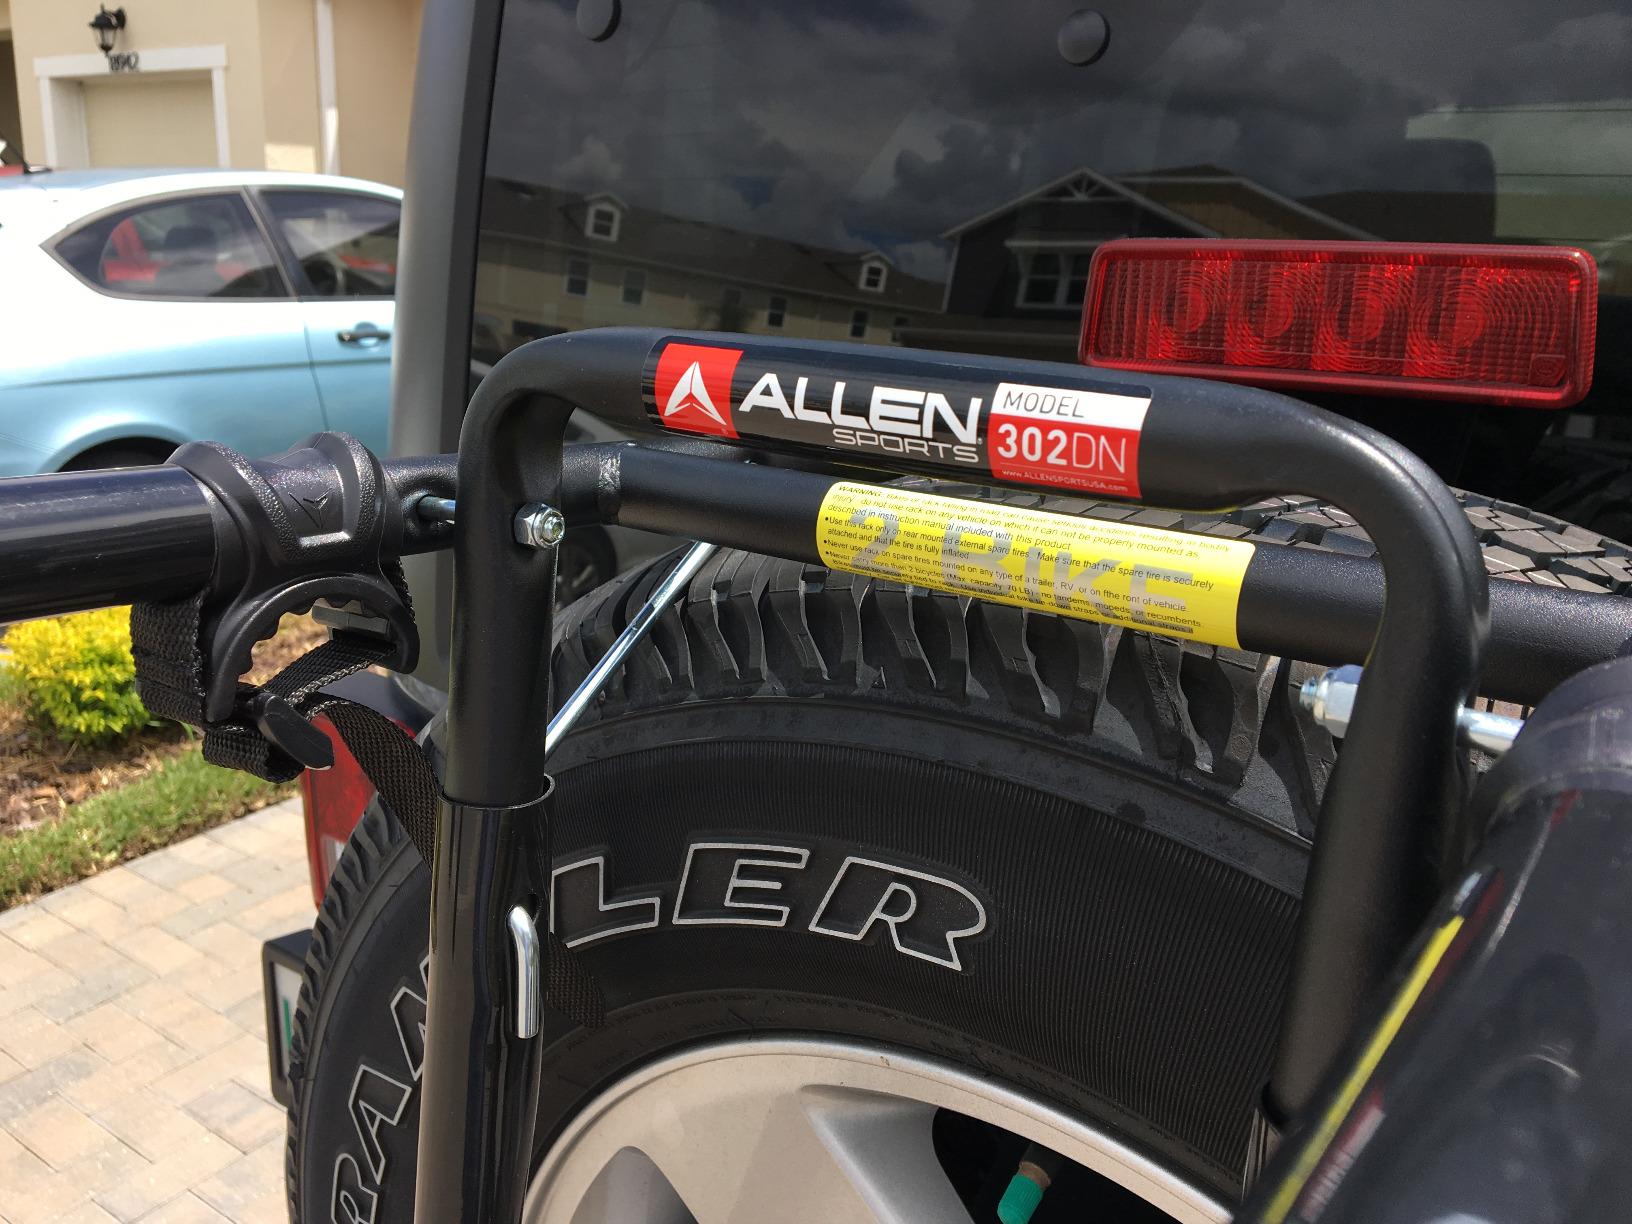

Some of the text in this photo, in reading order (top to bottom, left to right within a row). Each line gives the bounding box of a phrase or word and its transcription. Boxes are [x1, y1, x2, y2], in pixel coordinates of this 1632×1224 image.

[738, 373, 983, 444] ALLEN
[1003, 390, 1085, 418] MODEL
[832, 428, 979, 463] SPORTS
[997, 423, 1126, 474] 302DN
[1002, 469, 1128, 491] www.ALLENSPORTSUSA.com
[828, 503, 867, 516] described
[868, 509, 876, 517] in
[878, 511, 920, 525] instruction
[922, 520, 954, 530] manual
[955, 524, 993, 537] included
[996, 531, 1014, 540] with
[1016, 534, 1032, 543] this
[828, 527, 857, 539] attached
[859, 534, 872, 542] and
[874, 535, 888, 544] that
[889, 537, 901, 547] the
[903, 540, 914, 549] tire
[916, 542, 923, 551] is
[924, 544, 939, 556] fully
[888, 503, 904, 511] use
[905, 506, 923, 514] rack
[938, 511, 954, 520] any
[957, 514, 988, 524] vehicle
[1004, 521, 1030, 531] which
[1040, 527, 1058, 535] can
[1060, 530, 1077, 538] not
[1093, 536, 1134, 549] properly
[1136, 542, 1184, 555] mounted
[827, 539, 848, 549] Never
[892, 552, 913, 561] spare
[915, 555, 931, 564] tires
[932, 560, 965, 570] mounted
[980, 568, 994, 578] any
[996, 570, 1013, 581] type
[1103, 589, 1121, 599] fthe
[1123, 594, 1140, 603] ront
[1143, 597, 1152, 605] of
[829, 516, 843, 525] Use
[844, 519, 857, 528] this
[858, 522, 874, 531] rack
[876, 525, 891, 536] only
[903, 530, 919, 538] rear
[920, 533, 953, 544] mounted
[955, 539, 986, 550] external
[987, 544, 1010, 554] spare
[1037, 551, 1060, 563] Make
[1062, 557, 1081, 566] sure
[1083, 559, 1100, 570] that
[1103, 562, 1116, 572] the
[1118, 567, 1144, 577] spare
[1146, 570, 1161, 580] tire
[1163, 573, 1169, 582] is
[1174, 576, 1214, 592] securely
[850, 507, 899, 573] 2
[941, 519, 1193, 634] BIKE
